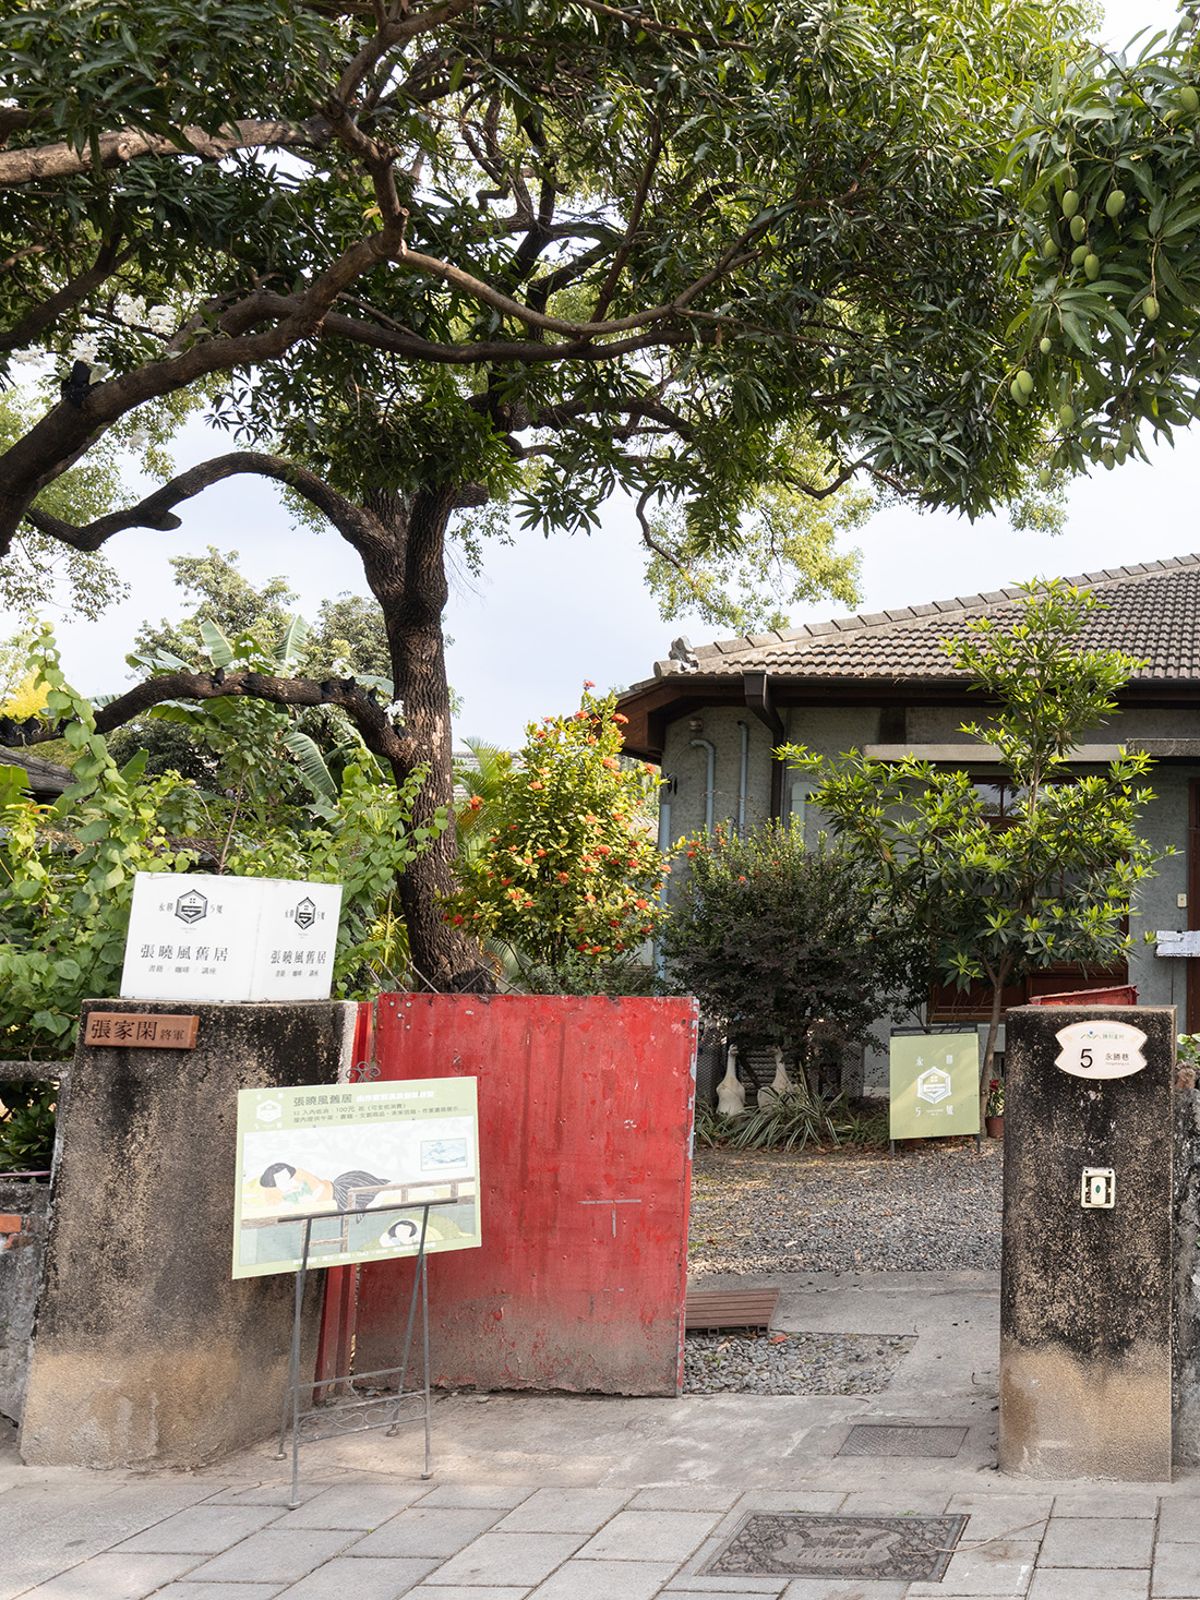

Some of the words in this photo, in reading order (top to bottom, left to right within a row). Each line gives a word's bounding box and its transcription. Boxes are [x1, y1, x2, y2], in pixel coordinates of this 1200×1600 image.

[140, 944, 228, 962] 張曉風舊居
[270, 950, 327, 964] 張曉風舊居
[1080, 1048, 1093, 1068] 5
[293, 1093, 353, 1107] 張曉風舊居
